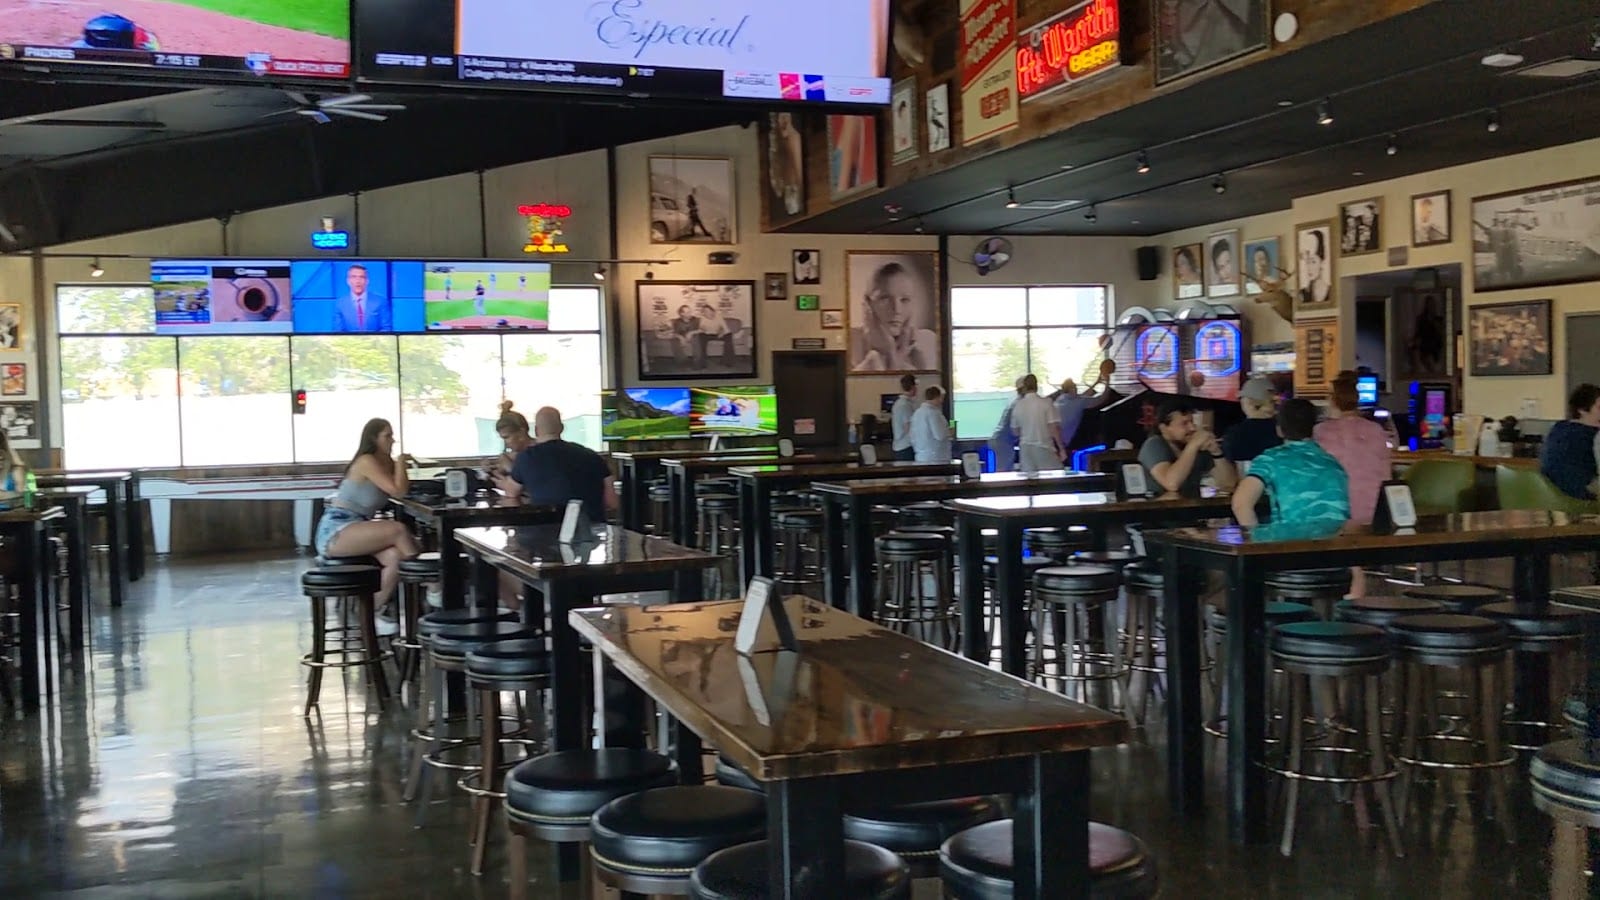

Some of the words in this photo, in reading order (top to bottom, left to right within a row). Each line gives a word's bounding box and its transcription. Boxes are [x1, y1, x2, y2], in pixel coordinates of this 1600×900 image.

[596, 0, 750, 58] Especial
[1043, 0, 1118, 68] Worth
[1068, 41, 1118, 73] BEER
